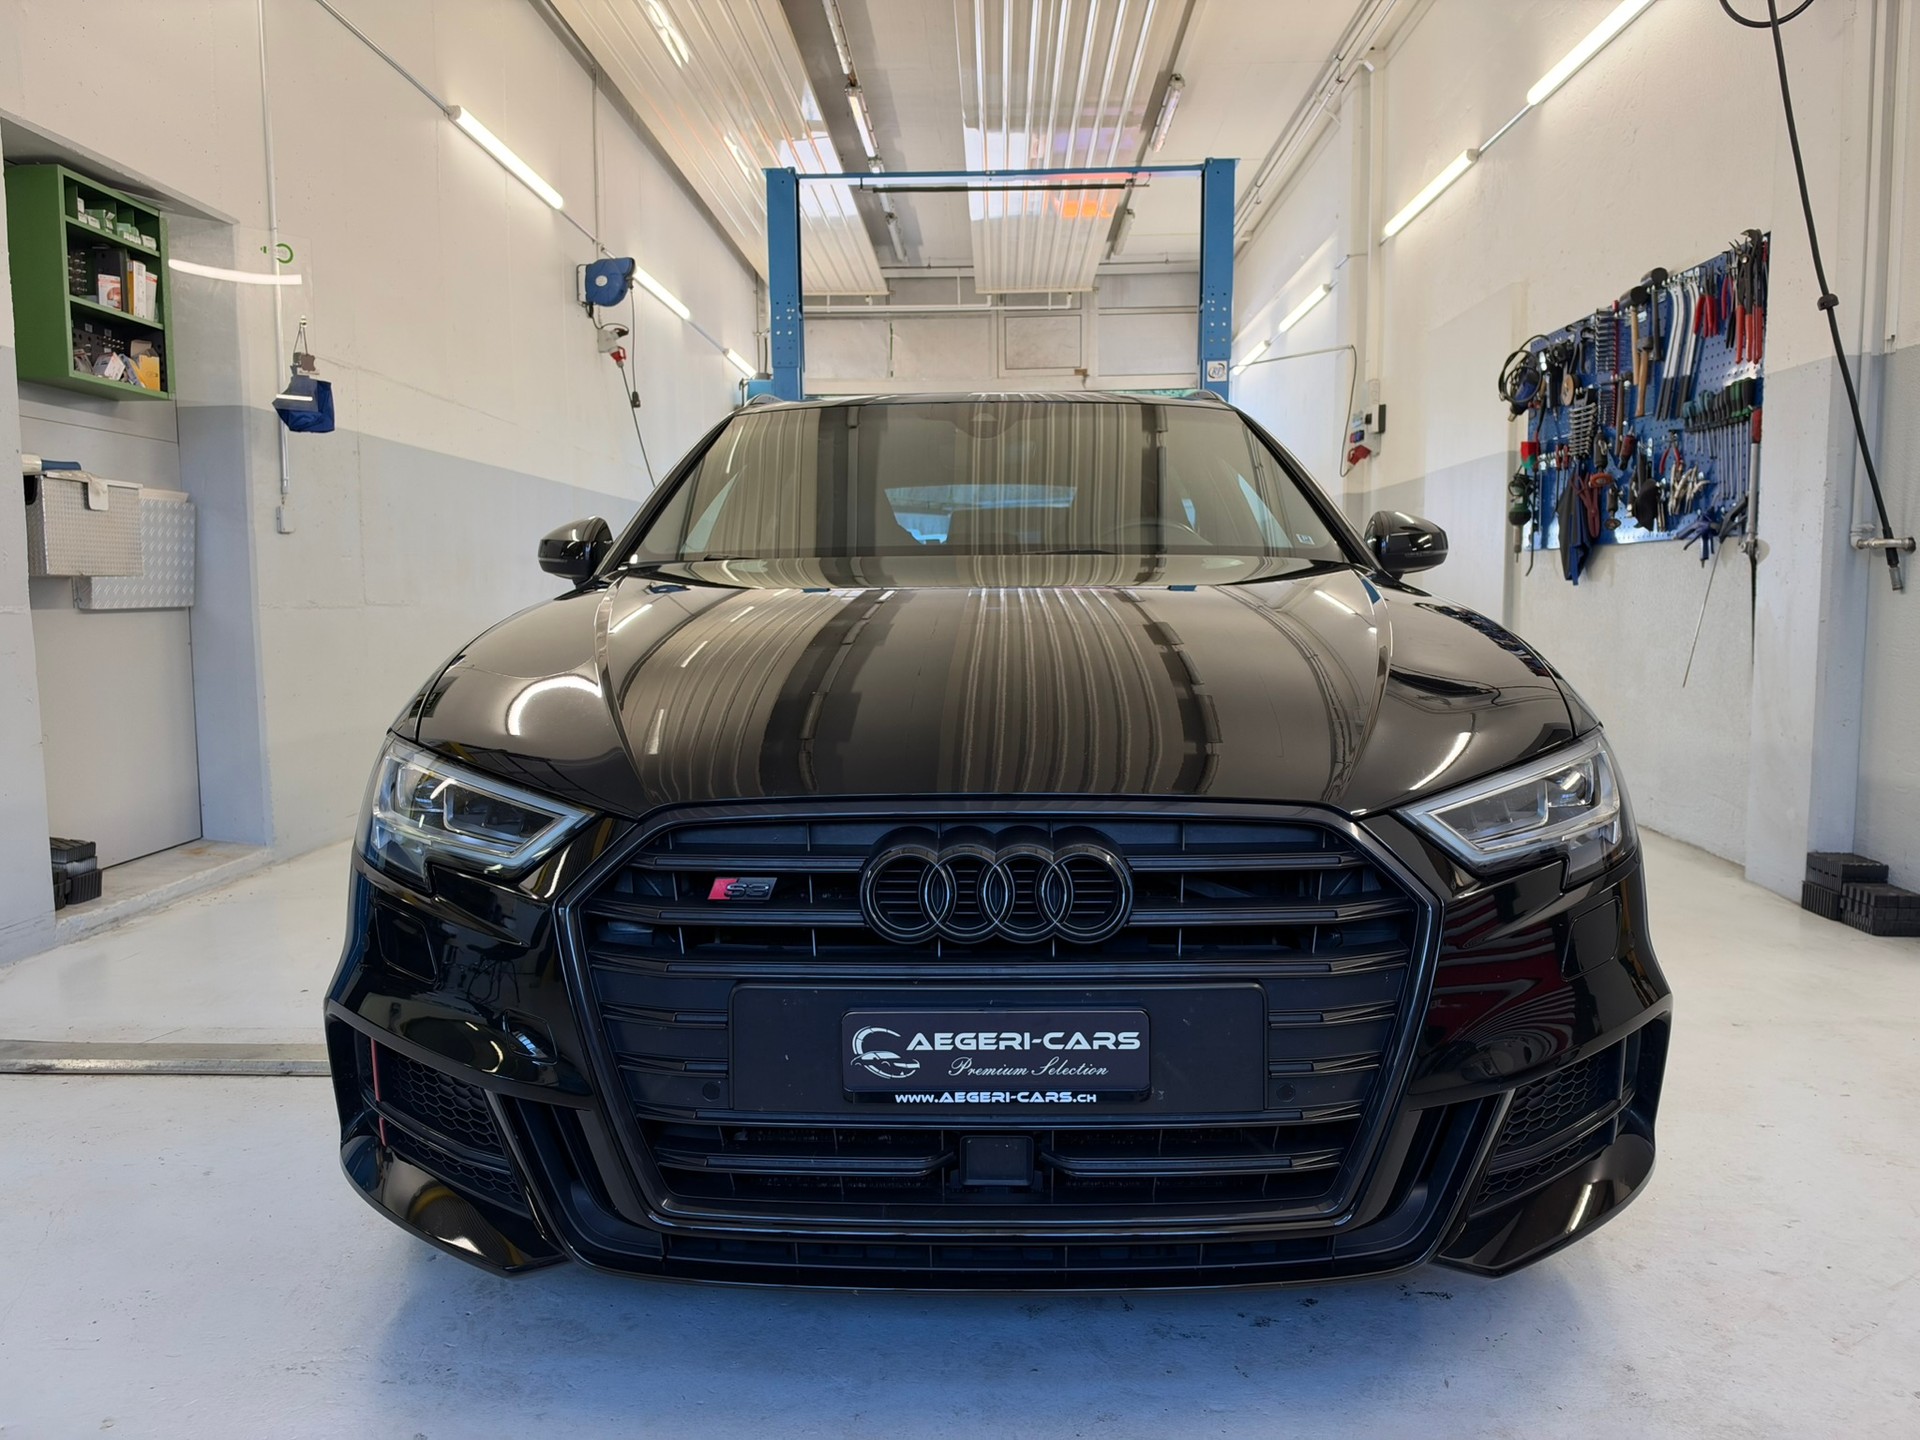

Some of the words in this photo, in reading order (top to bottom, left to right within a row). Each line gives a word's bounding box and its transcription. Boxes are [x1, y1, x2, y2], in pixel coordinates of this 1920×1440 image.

[906, 1031, 1141, 1051] AEGERI-CARS
[948, 1056, 1029, 1076] Premium
[1031, 1056, 1109, 1076] Selection
